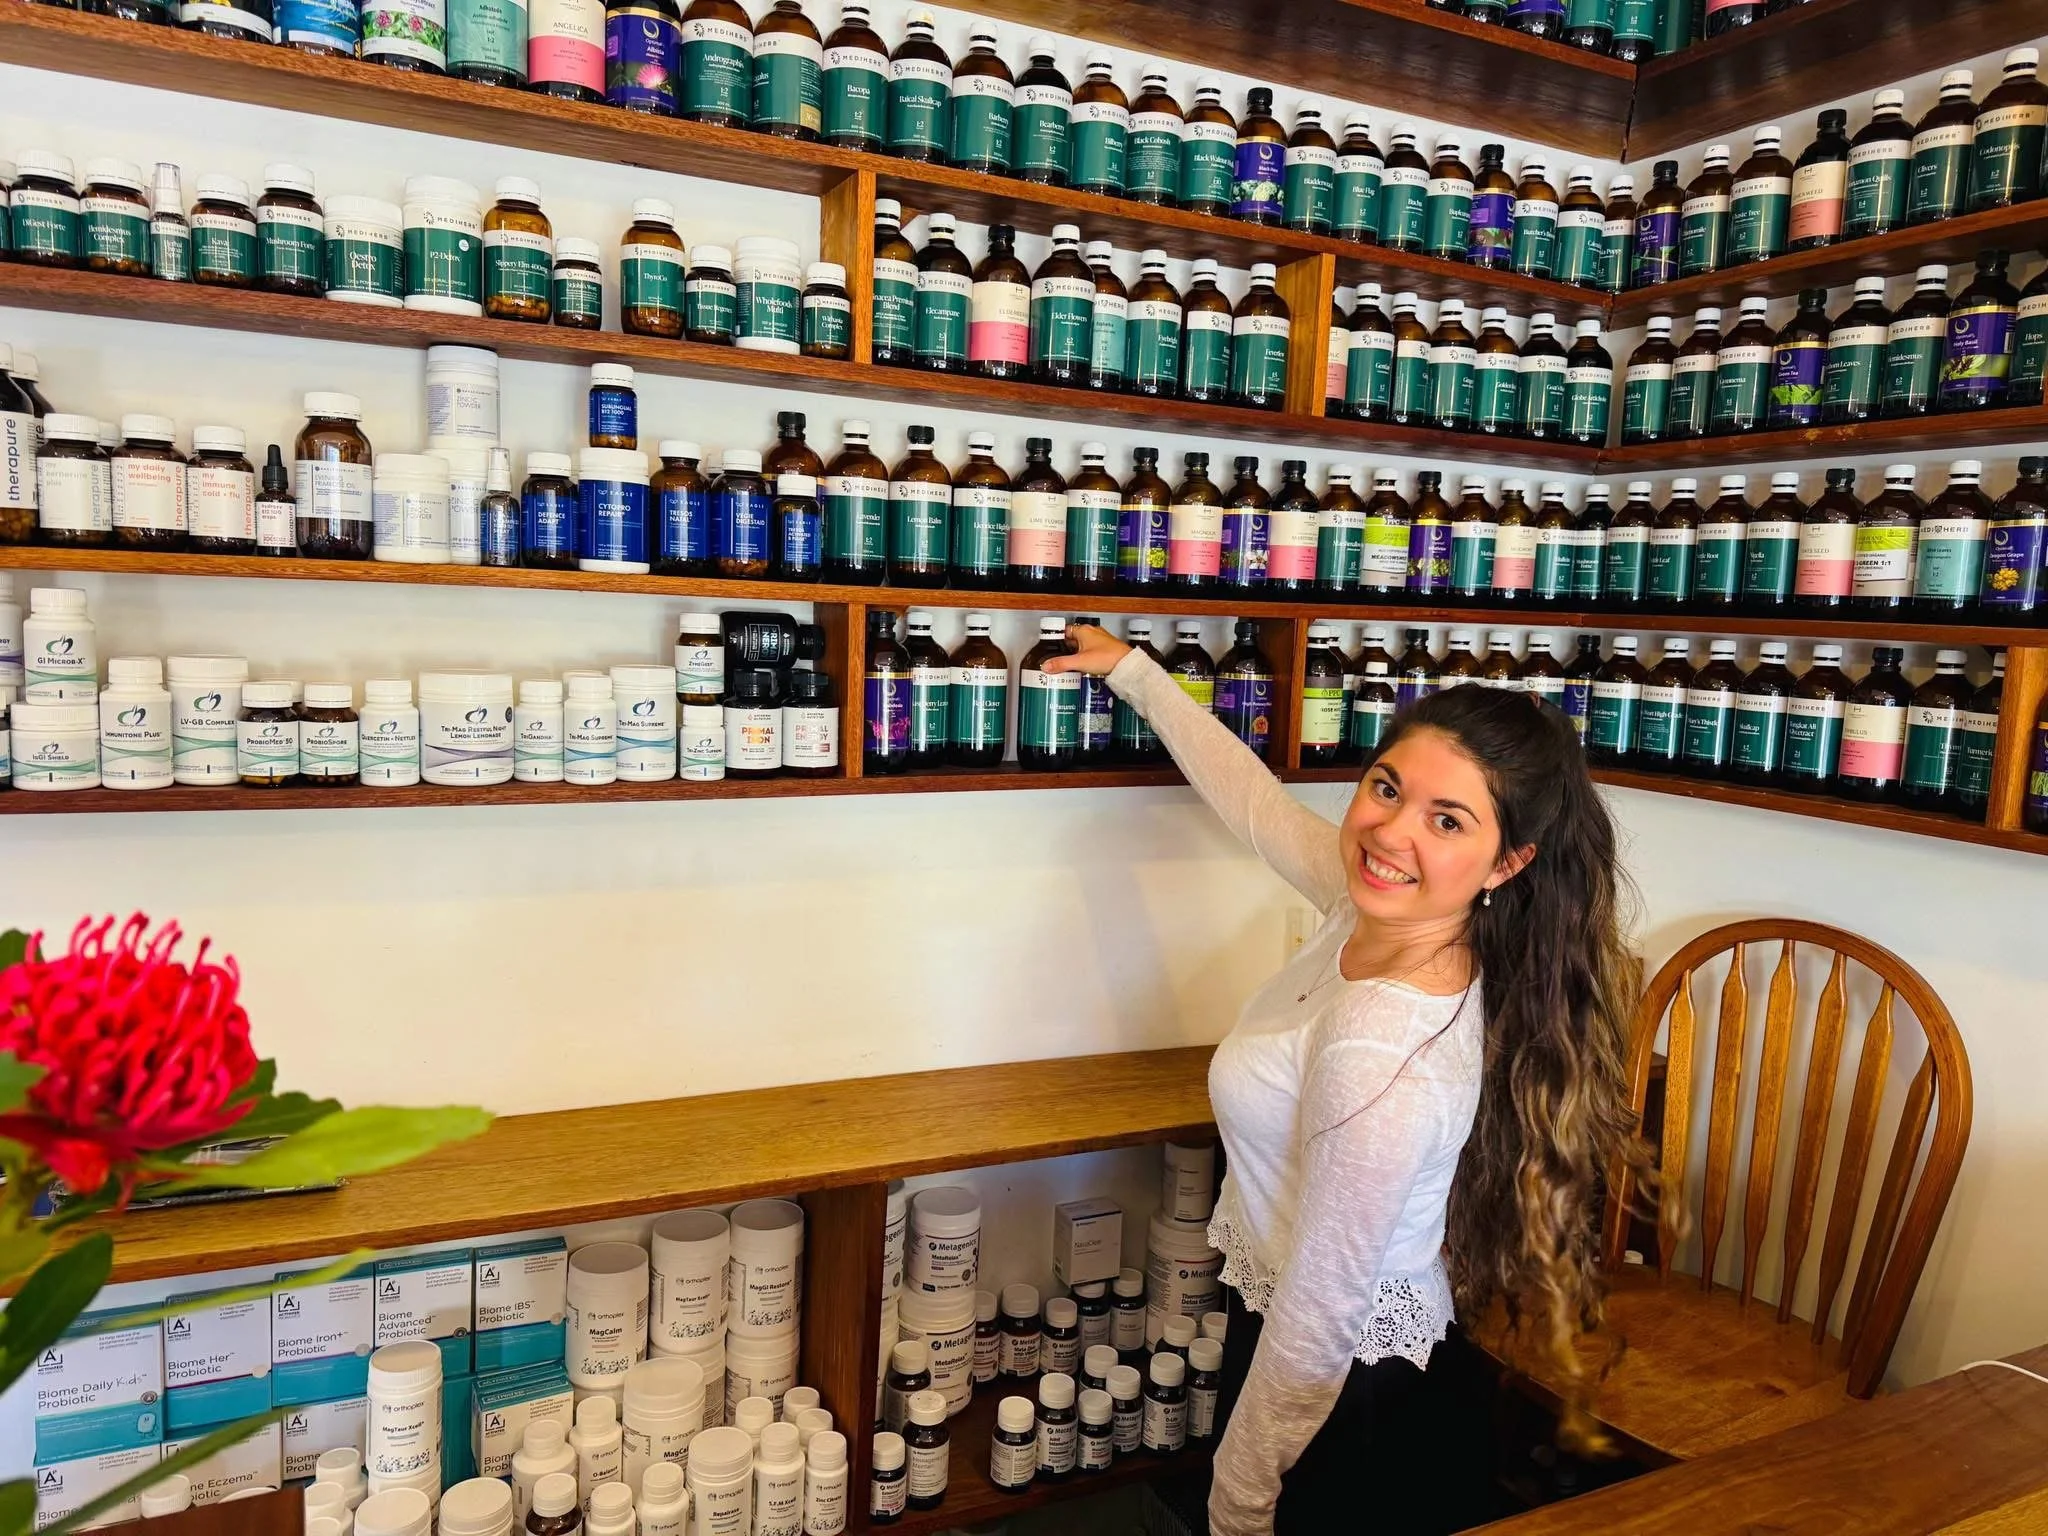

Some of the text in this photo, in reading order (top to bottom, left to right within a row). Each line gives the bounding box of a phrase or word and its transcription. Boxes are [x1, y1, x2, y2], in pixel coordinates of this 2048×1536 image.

[553, 21, 589, 35] ANGELICA
[707, 26, 748, 42] MEDIHERB
[702, 53, 744, 69] Andrographis
[842, 54, 883, 67] MEDIHERB
[905, 65, 944, 77] MEDIHERB
[847, 84, 871, 95] Bacopa
[1138, 118, 1175, 127] MEDIHERB
[1983, 112, 2031, 126] MEDIHERB
[1917, 133, 1958, 146] MEDIHERB
[1194, 153, 1209, 163] Black
[1853, 147, 1894, 159] MEDIHERB
[437, 215, 477, 230] MEDIHERB
[266, 236, 299, 248] Mushroom
[349, 251, 377, 263] Oestro
[350, 260, 376, 272] Detox
[495, 259, 518, 271] Slippery
[928, 278, 965, 289] MEDIHERB
[1056, 284, 1092, 294] MEDIHERB
[756, 295, 793, 308] Wholefoods
[882, 301, 900, 312] Blend
[766, 305, 784, 315] Multi
[925, 307, 960, 318] Elecampane
[1892, 324, 1932, 336] MEDIHERB
[2025, 332, 2044, 343] Hops
[7, 417, 20, 502] therapure
[128, 462, 166, 474] my daily
[128, 472, 172, 484] wellbeing
[202, 472, 215, 481] my
[174, 464, 184, 527] therapure
[610, 490, 633, 498] EAGLE
[910, 488, 946, 498] MEDIHERB
[244, 475, 252, 536] therapure
[598, 503, 632, 513] CYTOPRO
[538, 511, 567, 520] DEFENCE
[598, 510, 622, 519] REPAIR
[670, 509, 694, 519] TRESOS
[735, 512, 755, 520] VEGIE
[538, 518, 560, 526] ADAPT
[735, 518, 766, 527] DIGESTAID
[2007, 551, 2025, 560] Grape
[37, 657, 46, 665] GI
[1600, 710, 1618, 718] Ginseng
[1791, 704, 1827, 713] MEDIHERB
[180, 718, 204, 727] LV-GB
[285, 737, 294, 745] 50
[938, 1239, 977, 1251] Metagenics
[931, 1253, 959, 1261] MetaRelax
[769, 1280, 790, 1291] Restore
[479, 1300, 532, 1317] Biome IBS
[378, 1310, 412, 1322] Biome
[479, 1312, 525, 1324] Probiotic
[598, 1311, 624, 1320] orthoplex
[378, 1316, 432, 1332] Advanced
[378, 1326, 427, 1340] Probiotic
[589, 1327, 622, 1337] MagCalm
[278, 1332, 343, 1348] Biome Iron+
[278, 1344, 326, 1357] Probiotic
[168, 1353, 230, 1370] Biome Her
[935, 1354, 965, 1366] MetaRelax
[168, 1364, 222, 1380] Probiotic
[38, 1375, 142, 1400] Biome Daily Kids
[38, 1393, 96, 1410] Probiotic
[393, 1401, 424, 1413] orthoplex
[208, 1472, 253, 1487] Eczema
